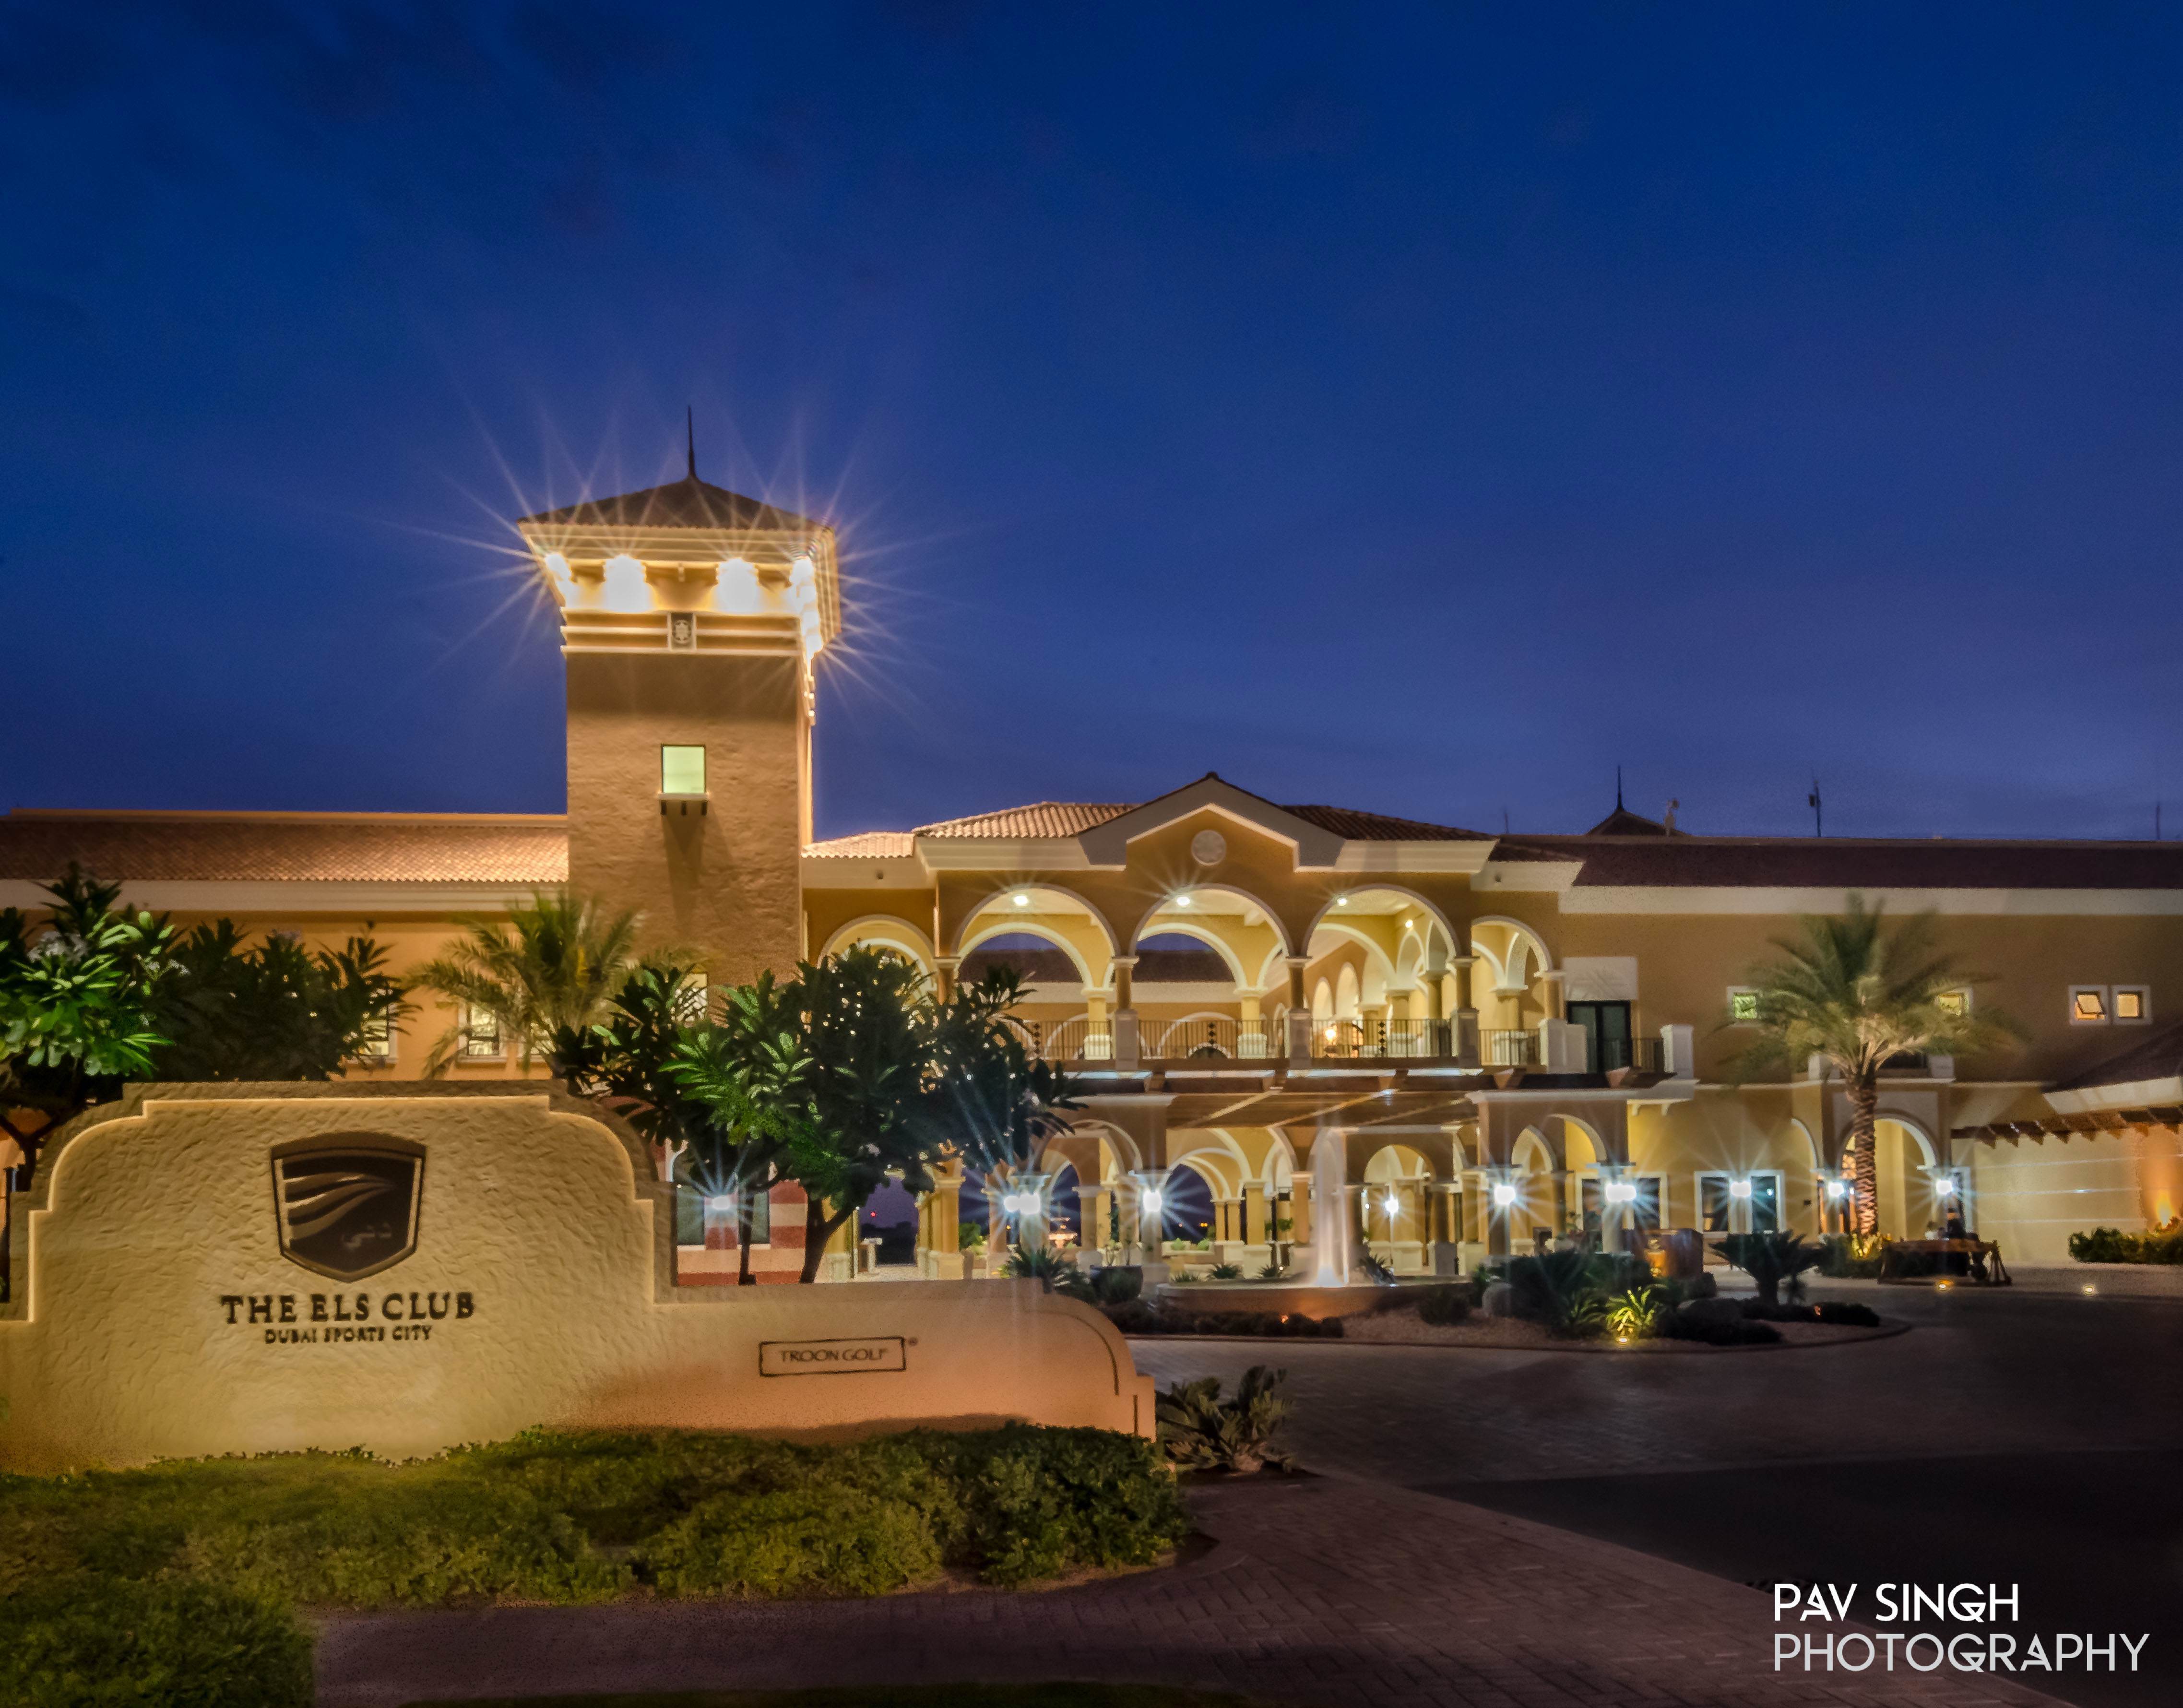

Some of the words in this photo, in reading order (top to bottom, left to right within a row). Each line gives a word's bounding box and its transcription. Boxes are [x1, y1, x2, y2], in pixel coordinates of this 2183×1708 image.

[220, 1293, 297, 1324] THE
[309, 1293, 370, 1322] ELS
[381, 1291, 475, 1320] CLUB
[265, 1328, 317, 1343] DUBAI
[392, 1324, 432, 1341] CITY
[781, 1349, 839, 1363] TROON
[842, 1348, 888, 1362] GOLF
